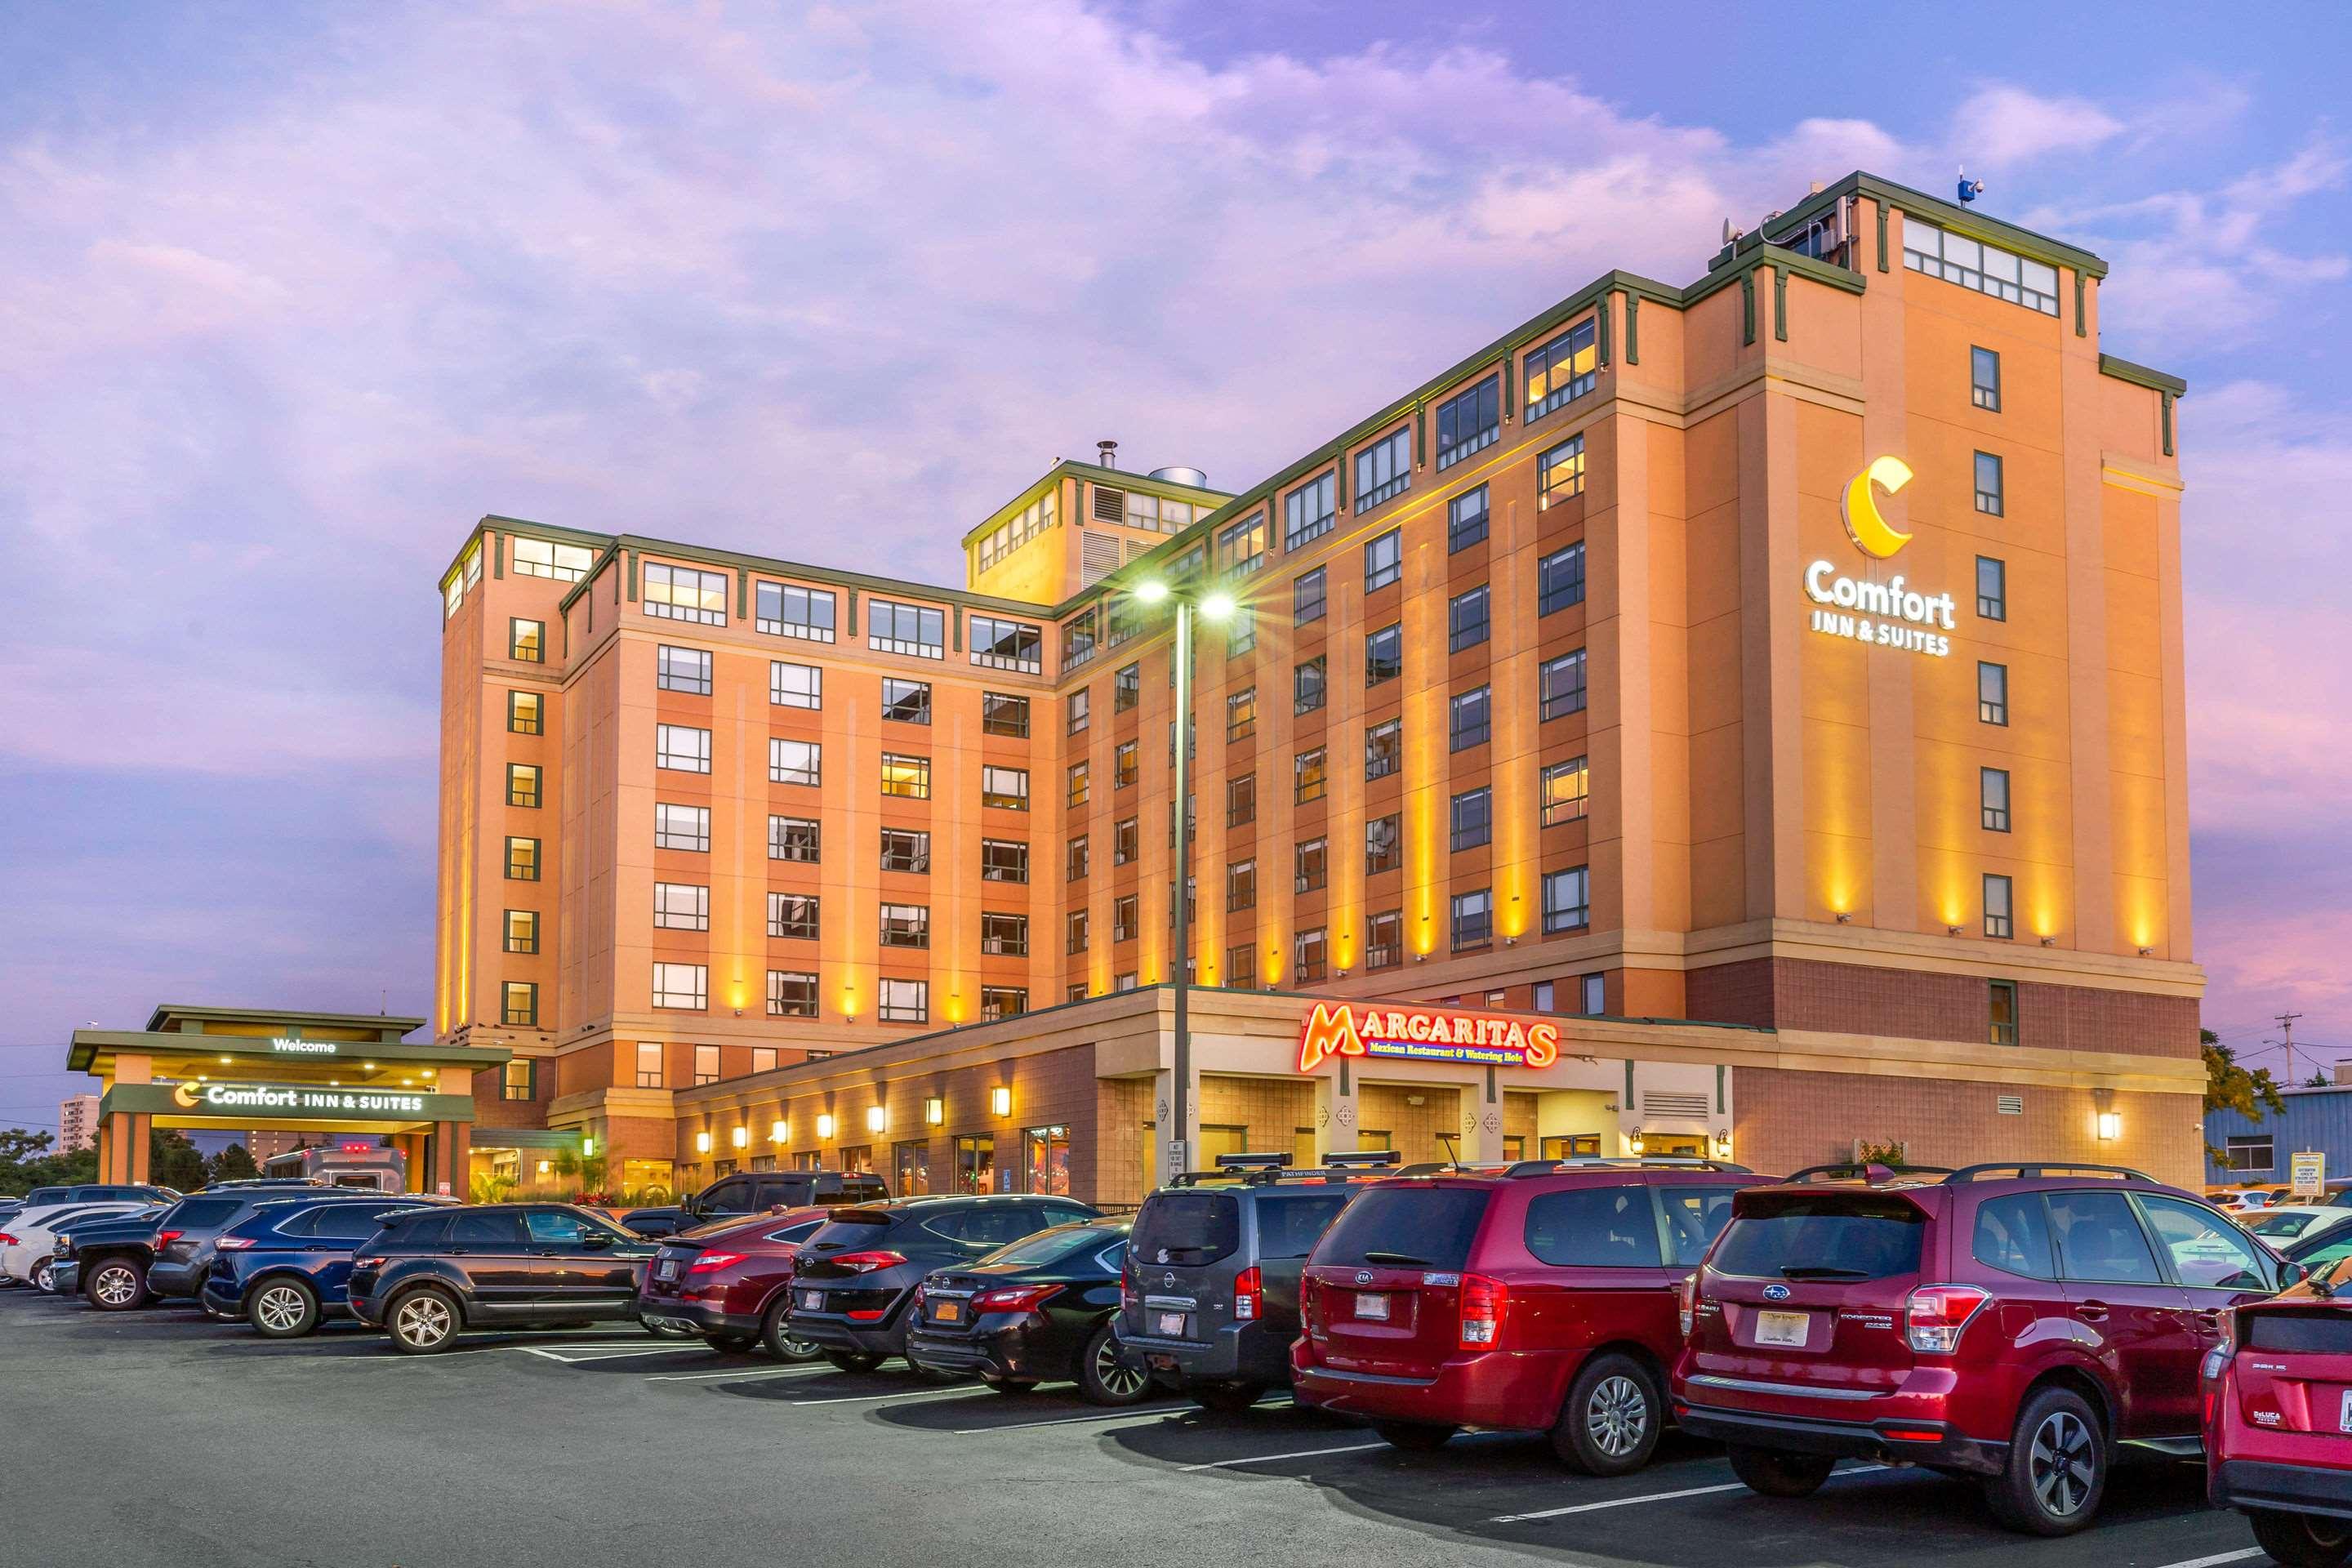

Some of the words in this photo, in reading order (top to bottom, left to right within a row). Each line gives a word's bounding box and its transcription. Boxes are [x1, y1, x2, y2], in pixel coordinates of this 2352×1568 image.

[1803, 560, 1956, 630] Comfort
[1811, 610, 1855, 638] INN
[1855, 620, 1873, 642] &
[1875, 623, 1949, 657] SUITES
[273, 1038, 336, 1054] Welcome
[1299, 1003, 1558, 1072] MARGARITAS
[1370, 1042, 1405, 1054] Mexican
[1406, 1045, 1454, 1058] Restaurant
[1465, 1049, 1503, 1063] Watering
[207, 1086, 296, 1107] Comfort
[304, 1094, 339, 1108] INN
[342, 1095, 356, 1109] &
[359, 1095, 423, 1111] SUITES
